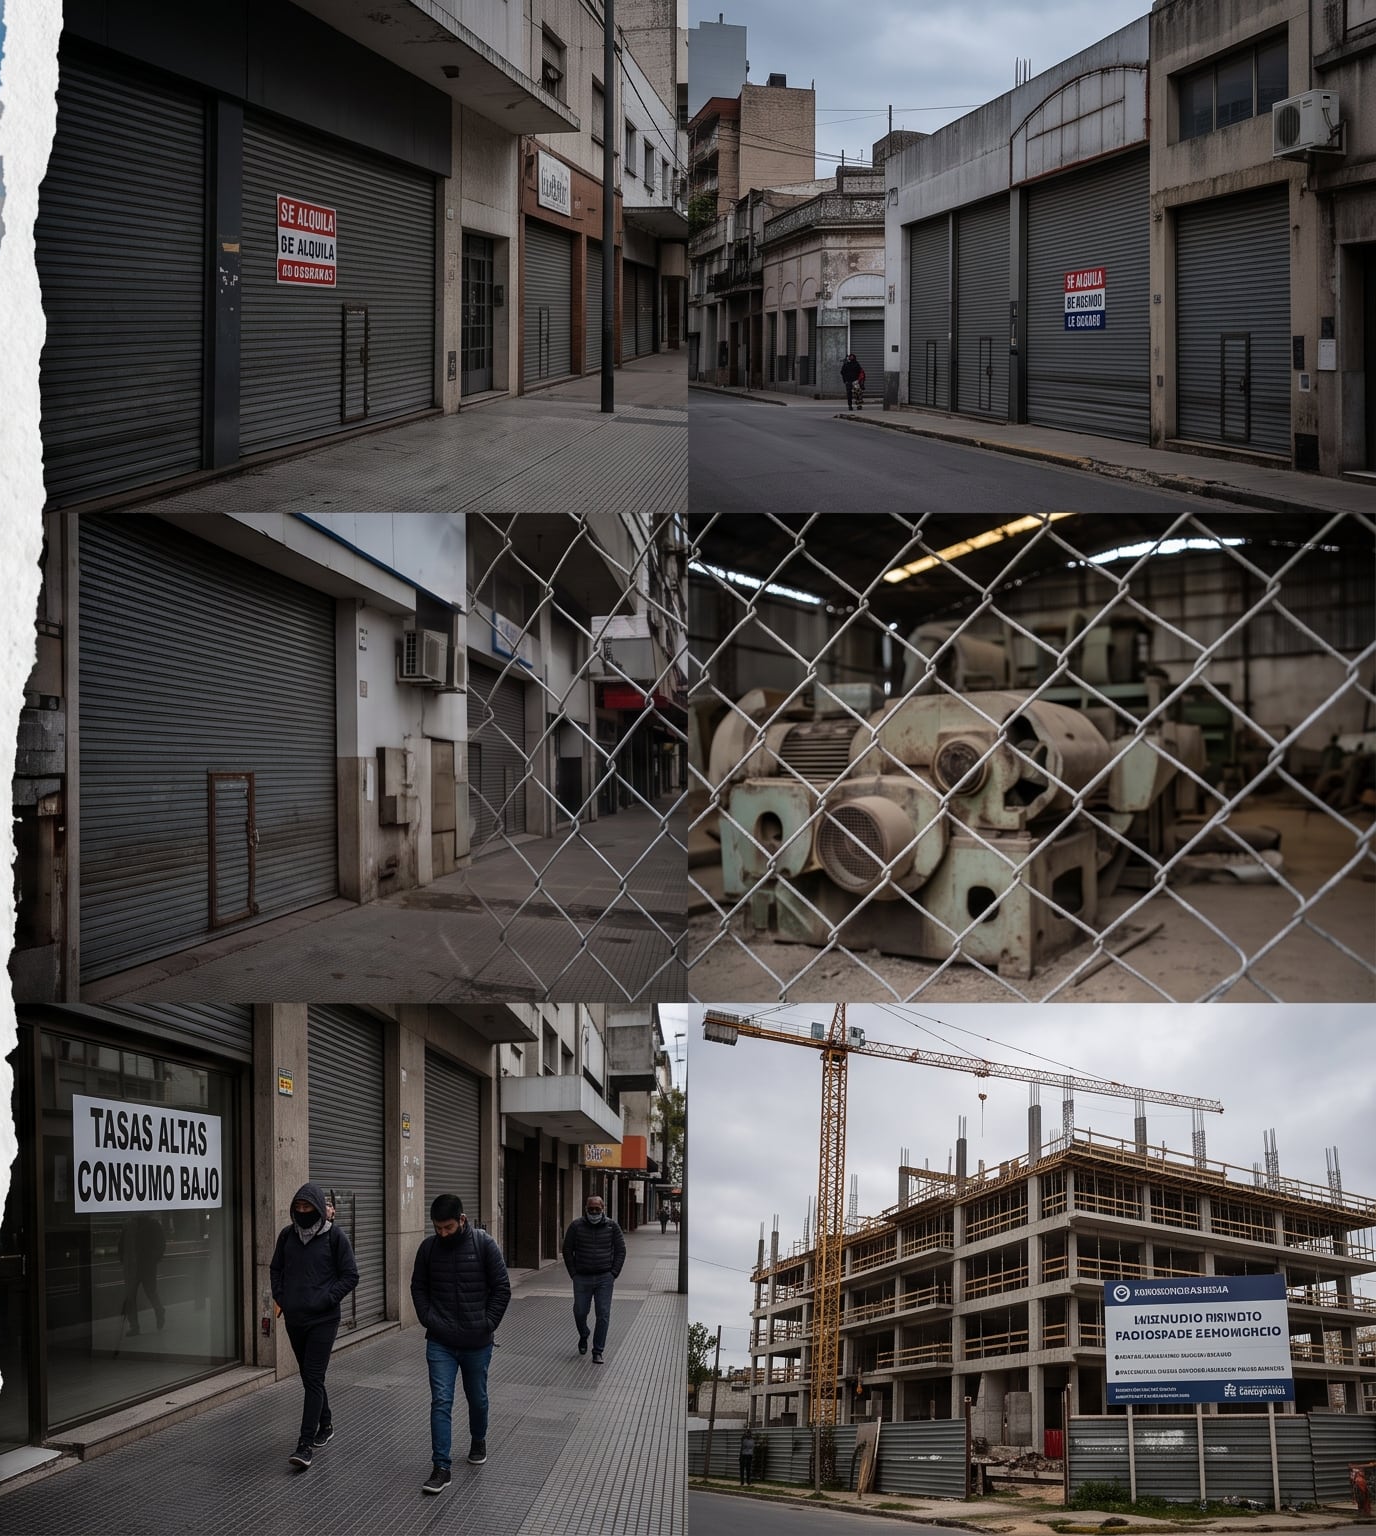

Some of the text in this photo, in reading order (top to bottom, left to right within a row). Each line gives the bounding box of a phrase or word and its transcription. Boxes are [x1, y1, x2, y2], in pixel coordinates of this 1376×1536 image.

[281, 202, 334, 233] SE ALQUILA
[297, 238, 335, 261] ALQUILA
[1067, 275, 1075, 289] SE
[90, 1107, 207, 1156] TASAS ALTAS
[77, 1160, 219, 1203] CONSUMO BAJO
